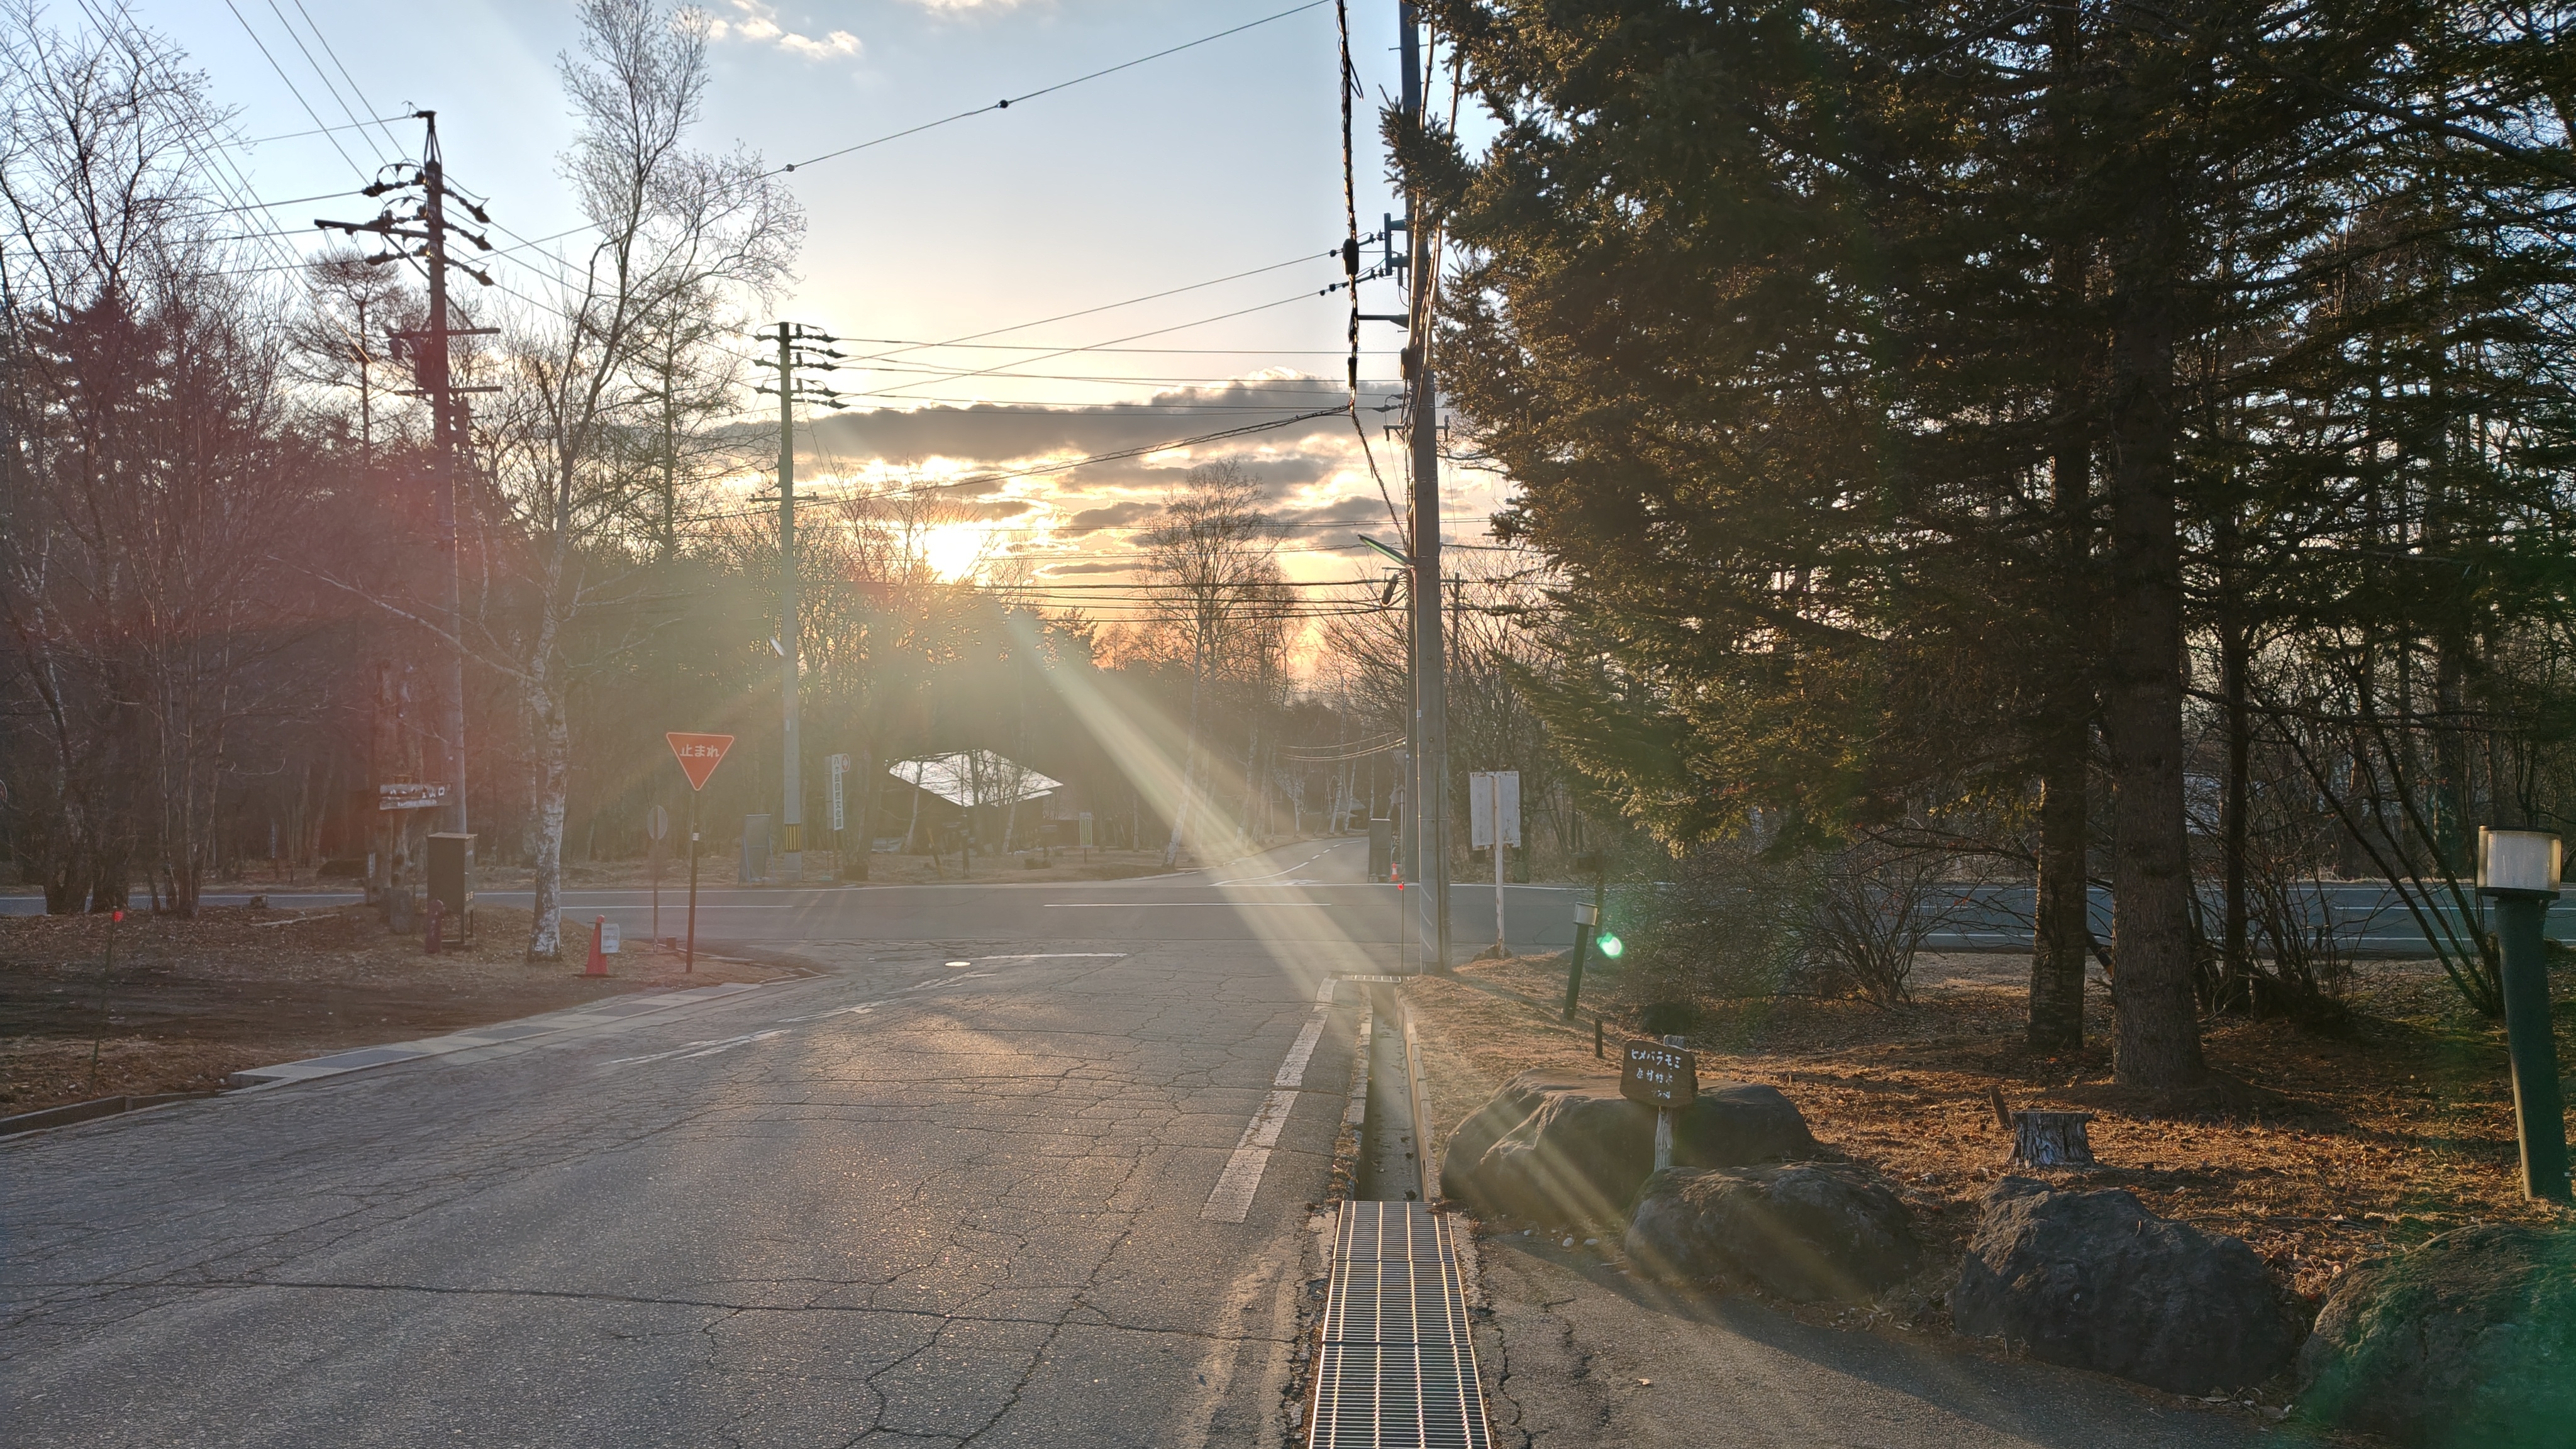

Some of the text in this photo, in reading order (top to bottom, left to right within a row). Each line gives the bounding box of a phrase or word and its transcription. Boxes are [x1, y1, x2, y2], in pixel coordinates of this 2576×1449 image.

[680, 744, 719, 757] 止まれ
[1631, 1048, 1681, 1069] ヒメバラモミ
